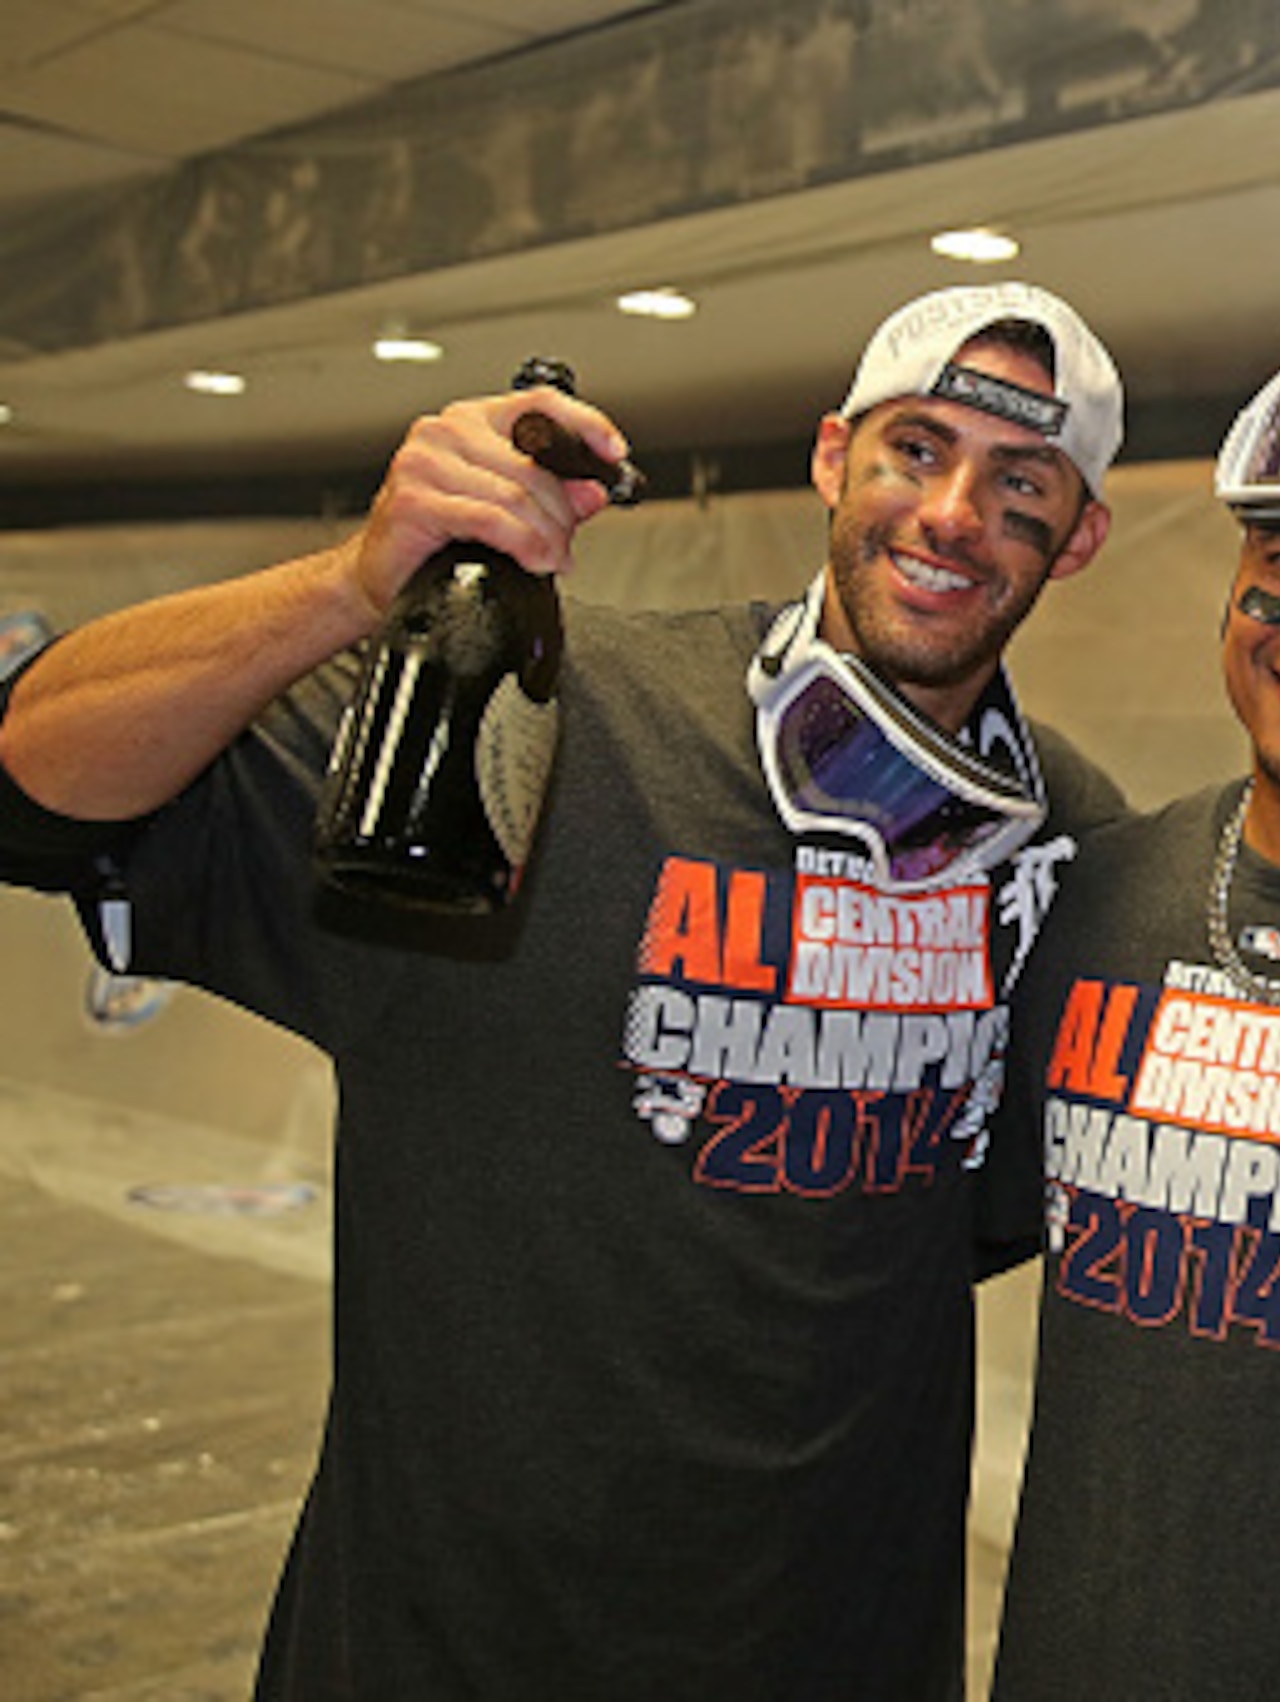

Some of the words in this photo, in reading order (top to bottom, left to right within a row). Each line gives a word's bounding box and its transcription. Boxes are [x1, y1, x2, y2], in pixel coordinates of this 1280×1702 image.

[638, 856, 777, 994] AL
[801, 884, 989, 948] CENTRAL
[790, 940, 990, 1006] DIVISION
[1046, 979, 1139, 1101] AL
